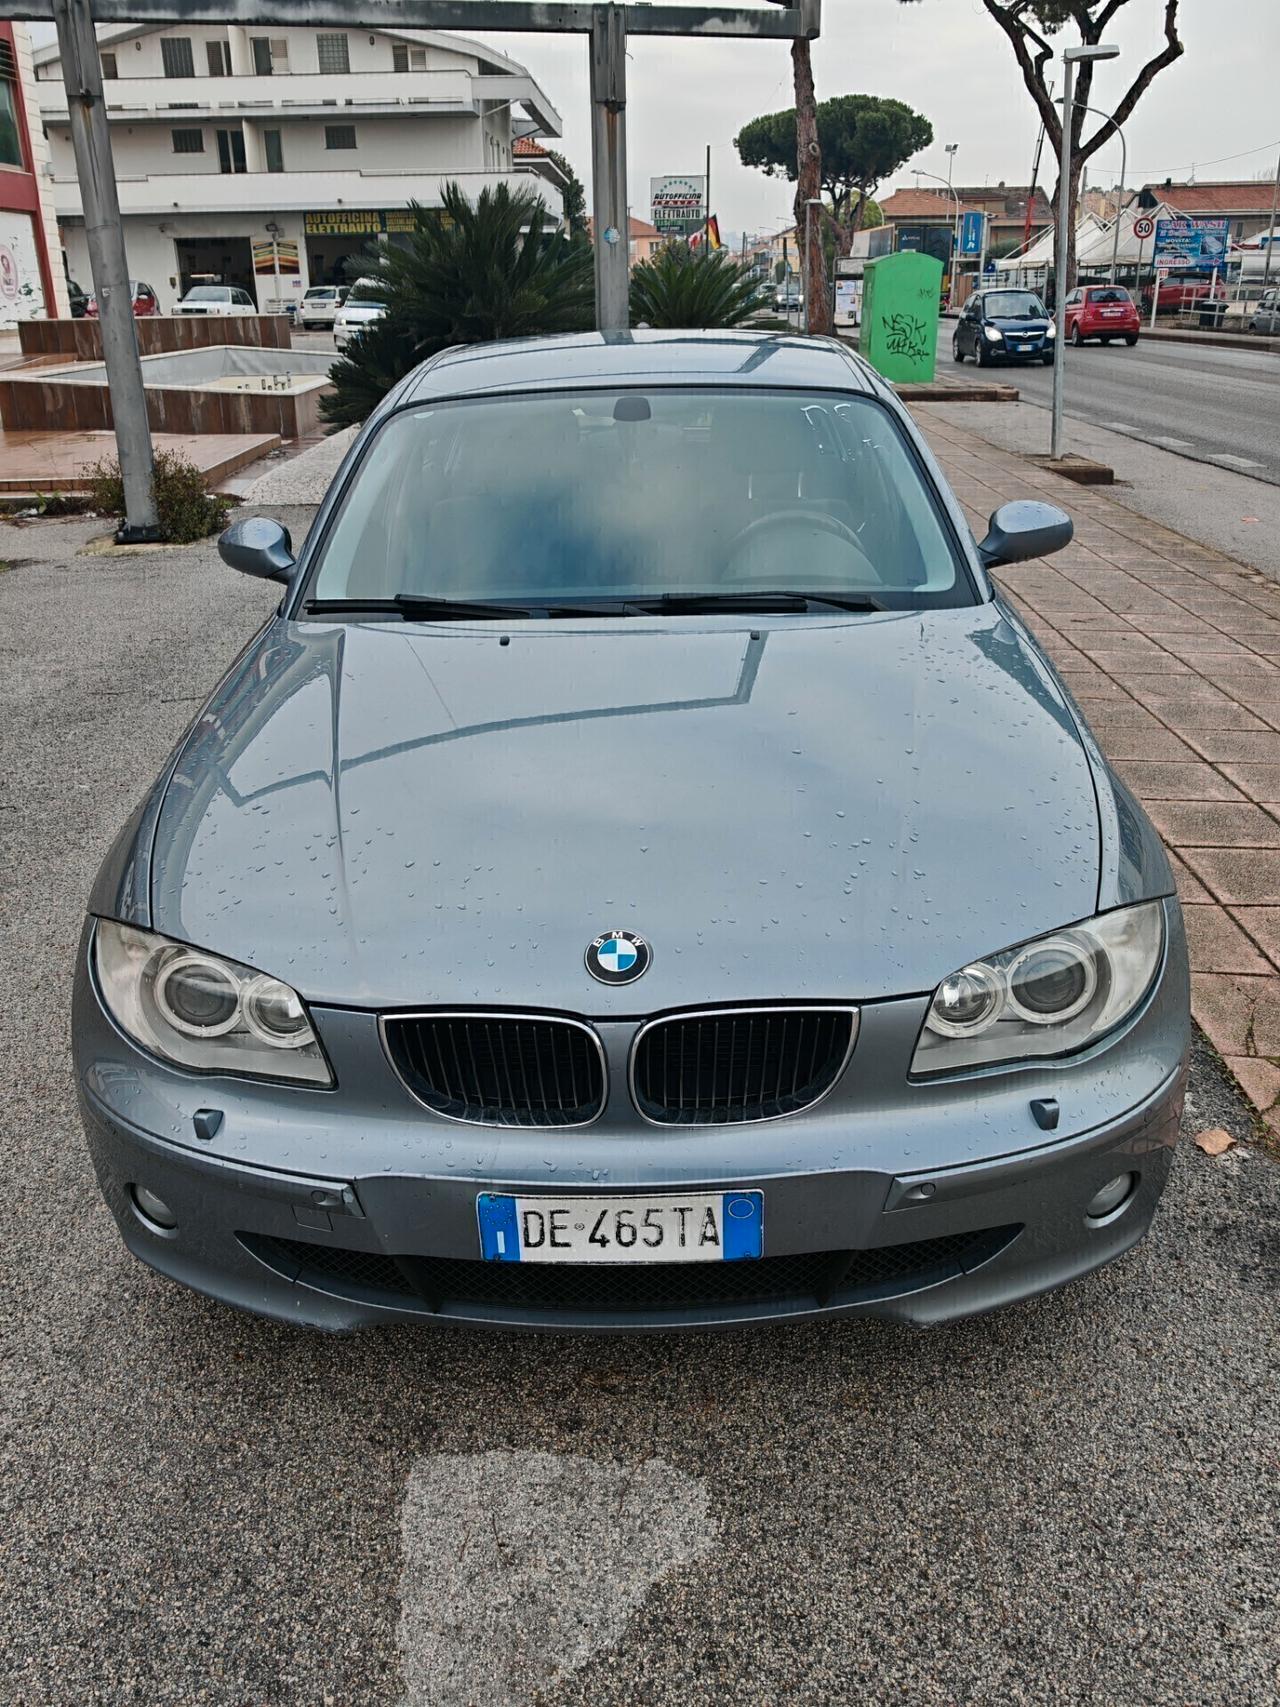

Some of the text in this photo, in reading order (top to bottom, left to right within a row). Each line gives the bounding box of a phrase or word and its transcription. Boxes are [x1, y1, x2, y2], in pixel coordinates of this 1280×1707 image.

[306, 212, 380, 223] AUTOFFICINA
[654, 209, 700, 219] ELETTRAUTO
[306, 223, 381, 233] ELETTRAUTO
[1138, 222, 1150, 233] 50
[1156, 258, 1191, 266] INGRESSO
[593, 931, 644, 947] BMW
[523, 1206, 720, 1248] DE 465TA
